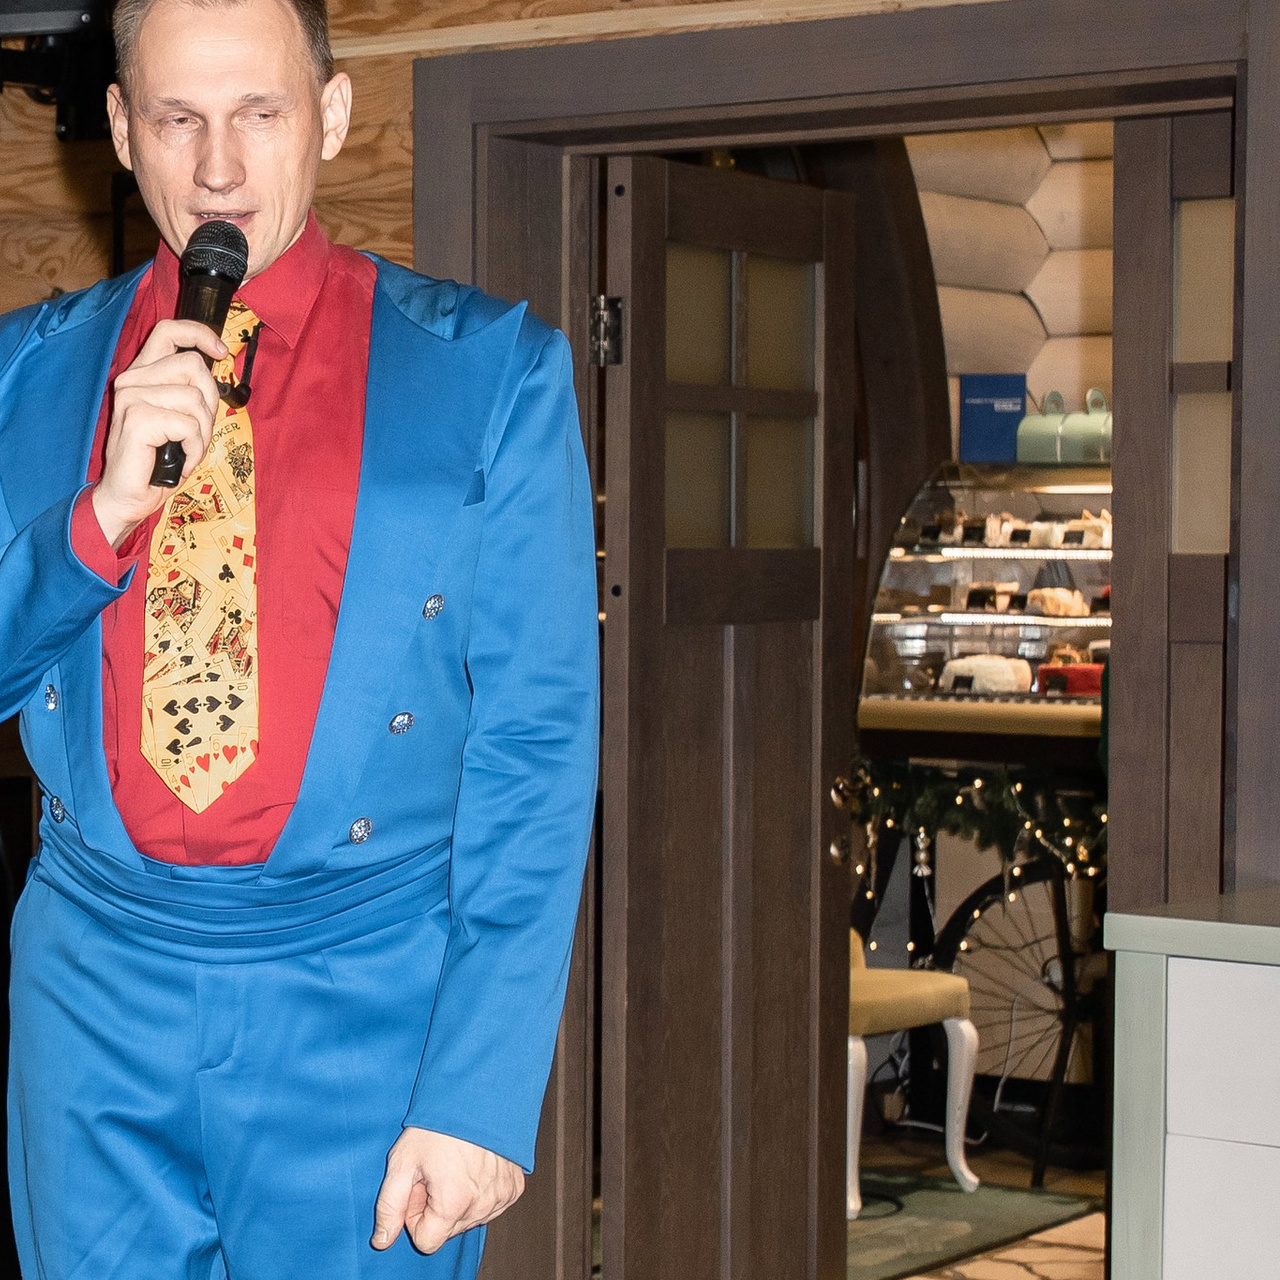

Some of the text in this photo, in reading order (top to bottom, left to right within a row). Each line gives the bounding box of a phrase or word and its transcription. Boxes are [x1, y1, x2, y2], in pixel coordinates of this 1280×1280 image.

[208, 422, 241, 454] JOKER
[189, 530, 196, 542] A
[225, 596, 234, 606] J
[160, 621, 170, 633] K
[241, 732, 248, 745] 7
[212, 738, 221, 752] 6
[185, 752, 195, 766] 5
[171, 774, 178, 784] 4
